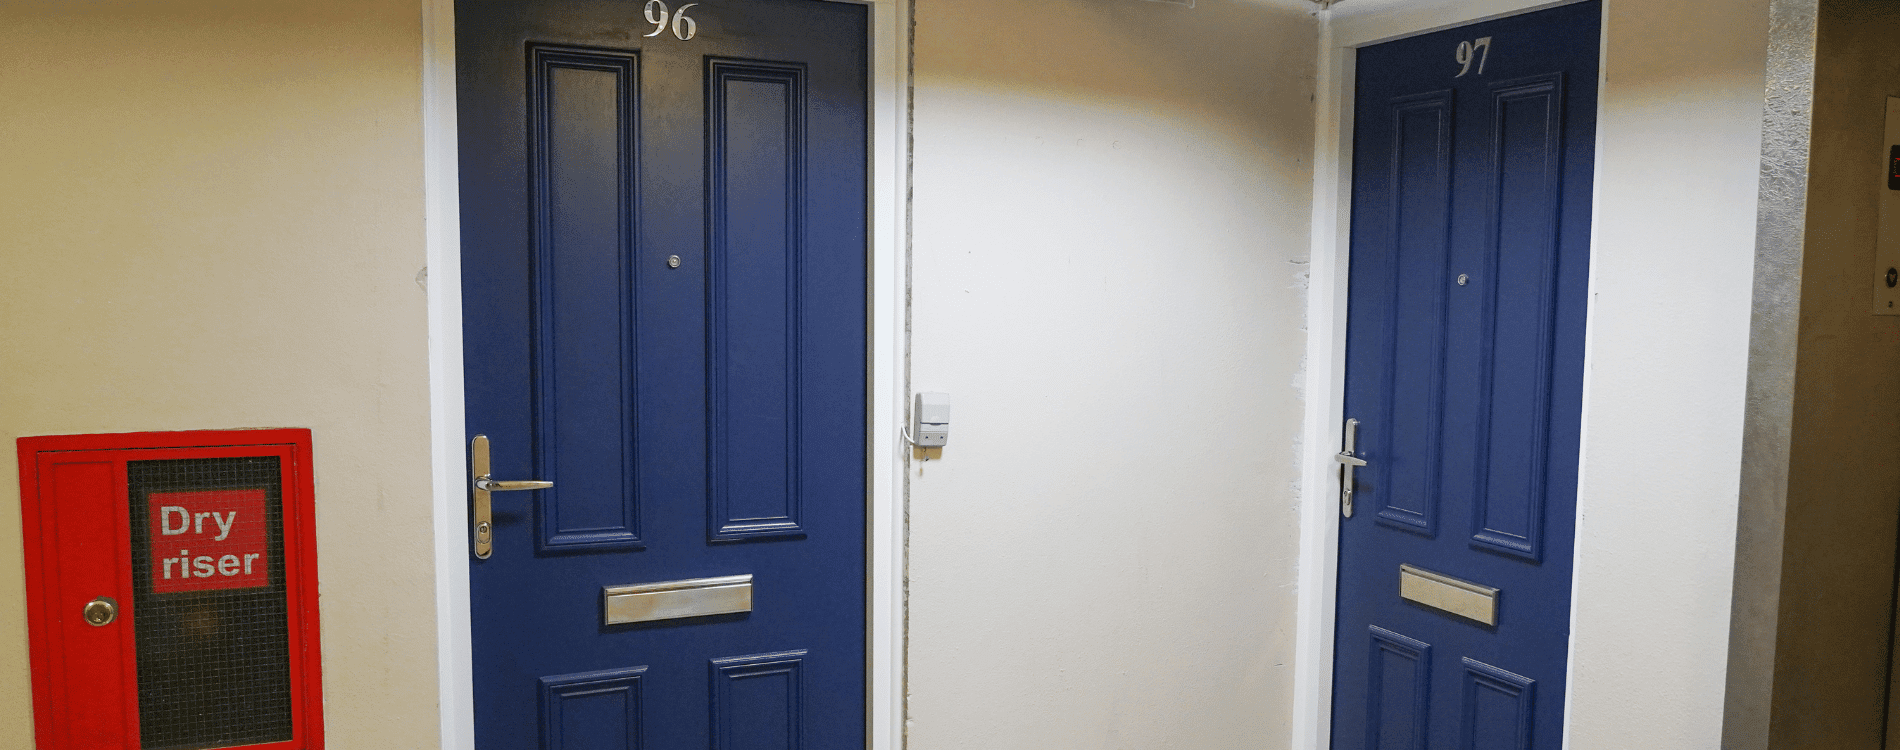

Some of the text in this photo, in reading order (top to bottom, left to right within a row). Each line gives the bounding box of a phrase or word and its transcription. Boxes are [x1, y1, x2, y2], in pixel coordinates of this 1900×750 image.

[643, 0, 699, 40] 96
[1454, 36, 1493, 78] 97
[161, 506, 237, 541] Dry
[163, 549, 260, 579] riser
